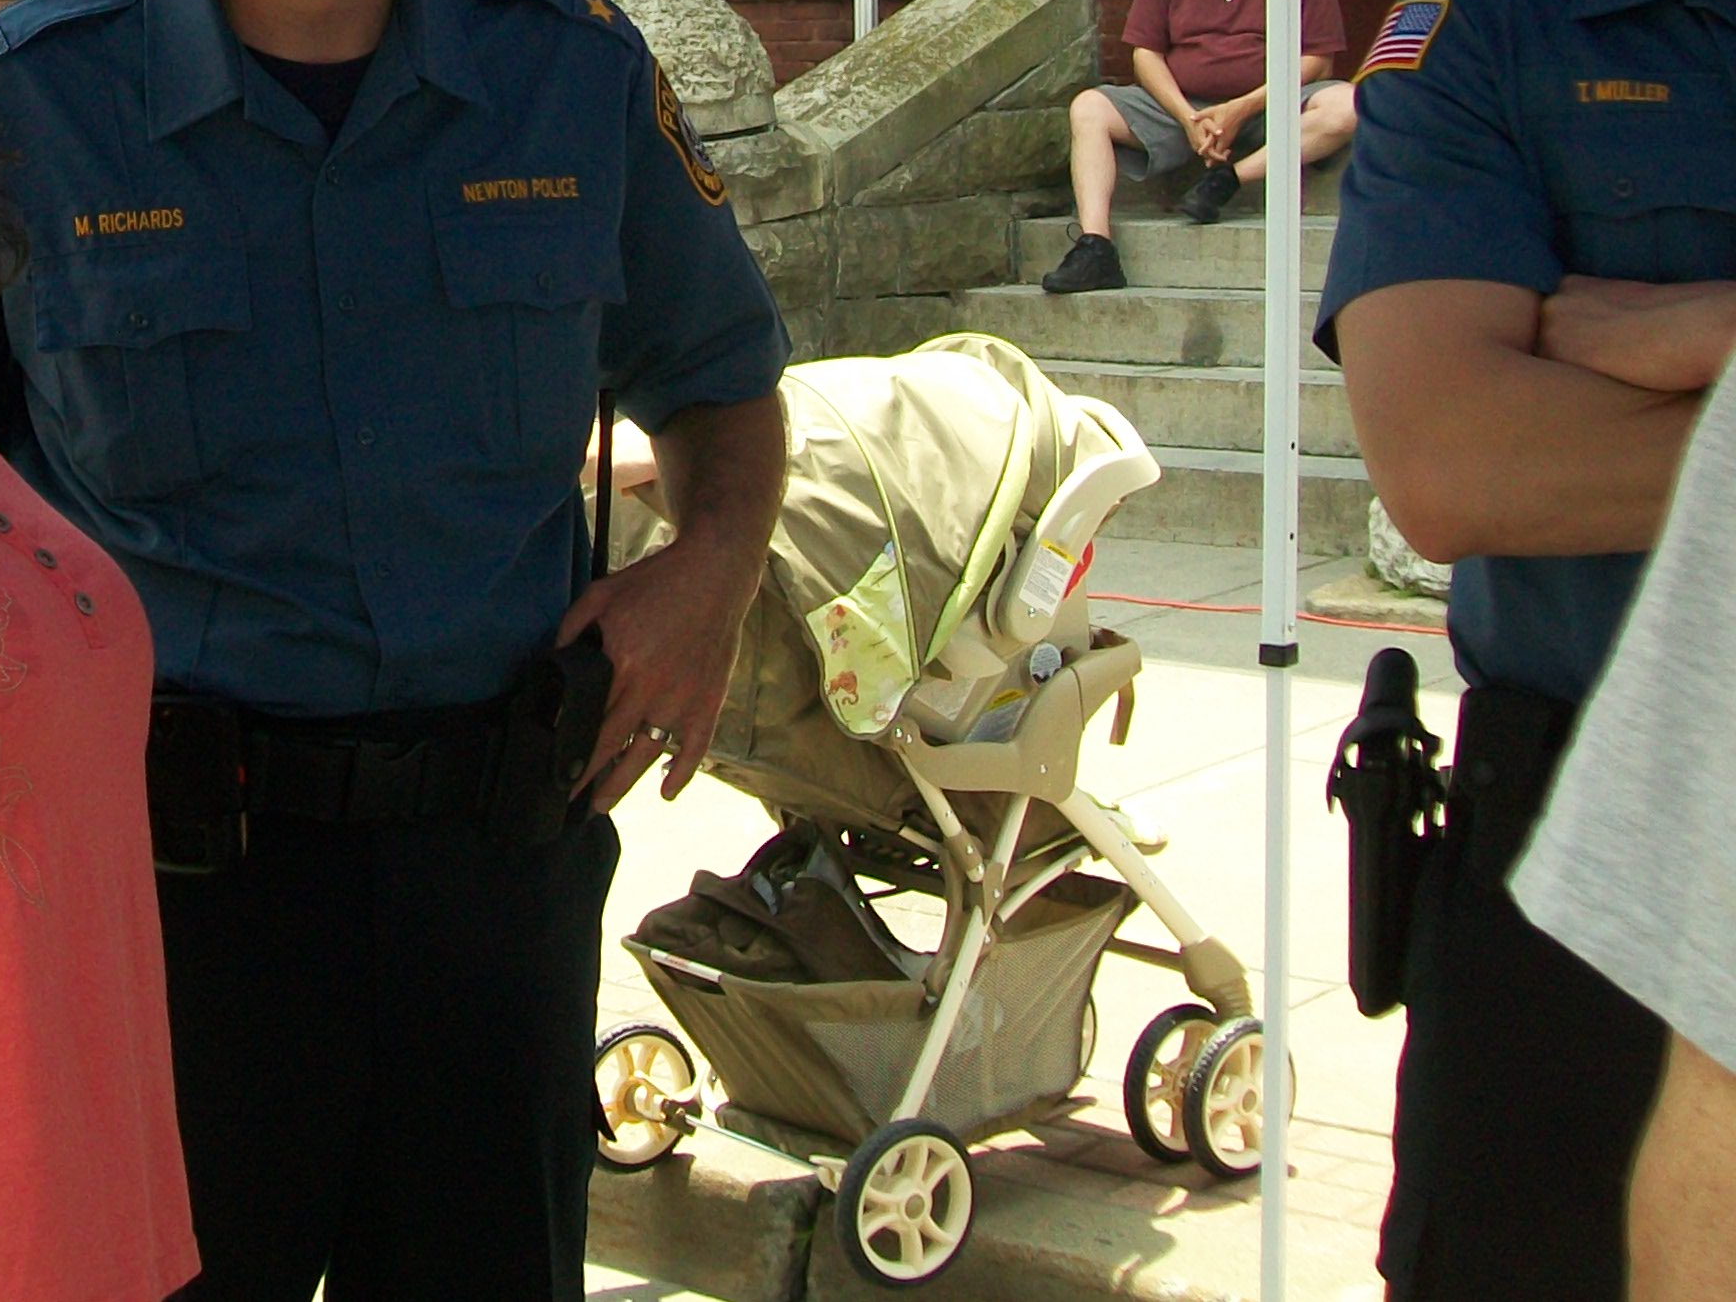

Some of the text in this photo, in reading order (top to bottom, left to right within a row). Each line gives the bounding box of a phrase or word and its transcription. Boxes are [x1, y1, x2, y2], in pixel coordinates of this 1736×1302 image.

[463, 177, 579, 203] NEWTON POLICE
[74, 208, 185, 237] M. RICHARDS
